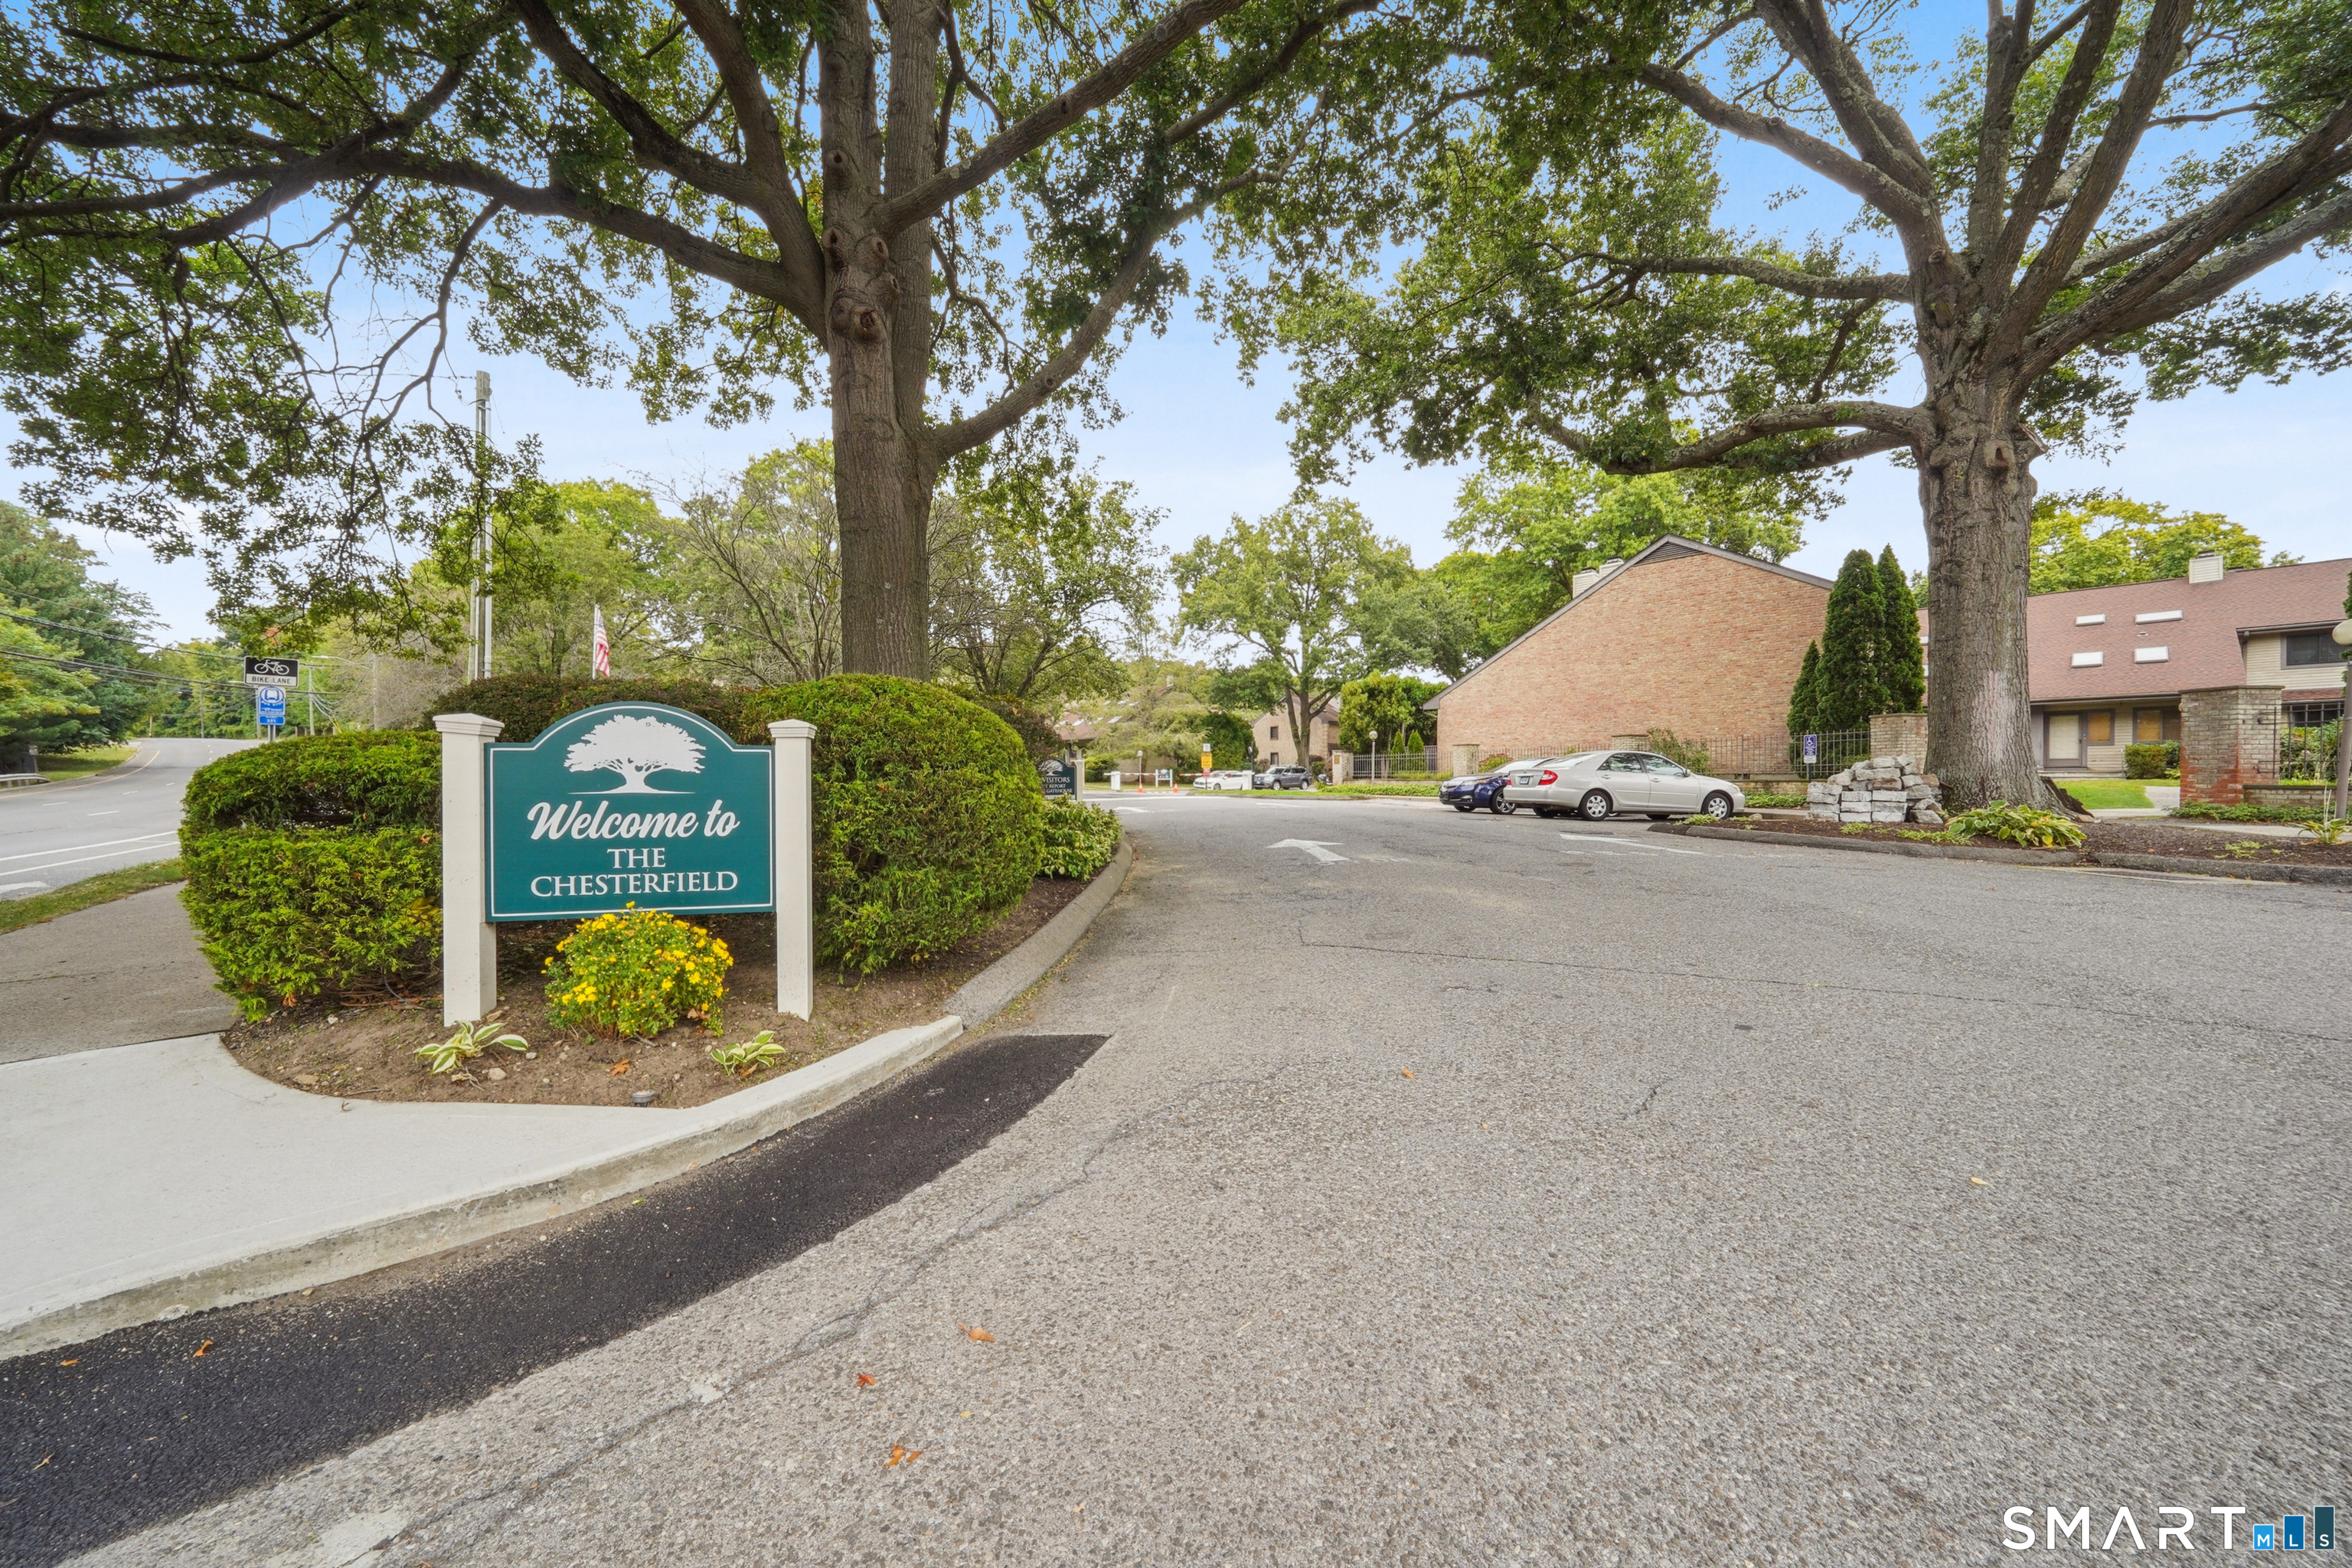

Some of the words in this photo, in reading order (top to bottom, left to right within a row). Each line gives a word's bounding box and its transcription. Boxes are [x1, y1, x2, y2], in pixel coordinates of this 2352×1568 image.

[527, 800, 698, 840] Welcome
[704, 799, 740, 837] to
[607, 848, 666, 869] THE
[531, 871, 739, 897] CHESTERFIELD
